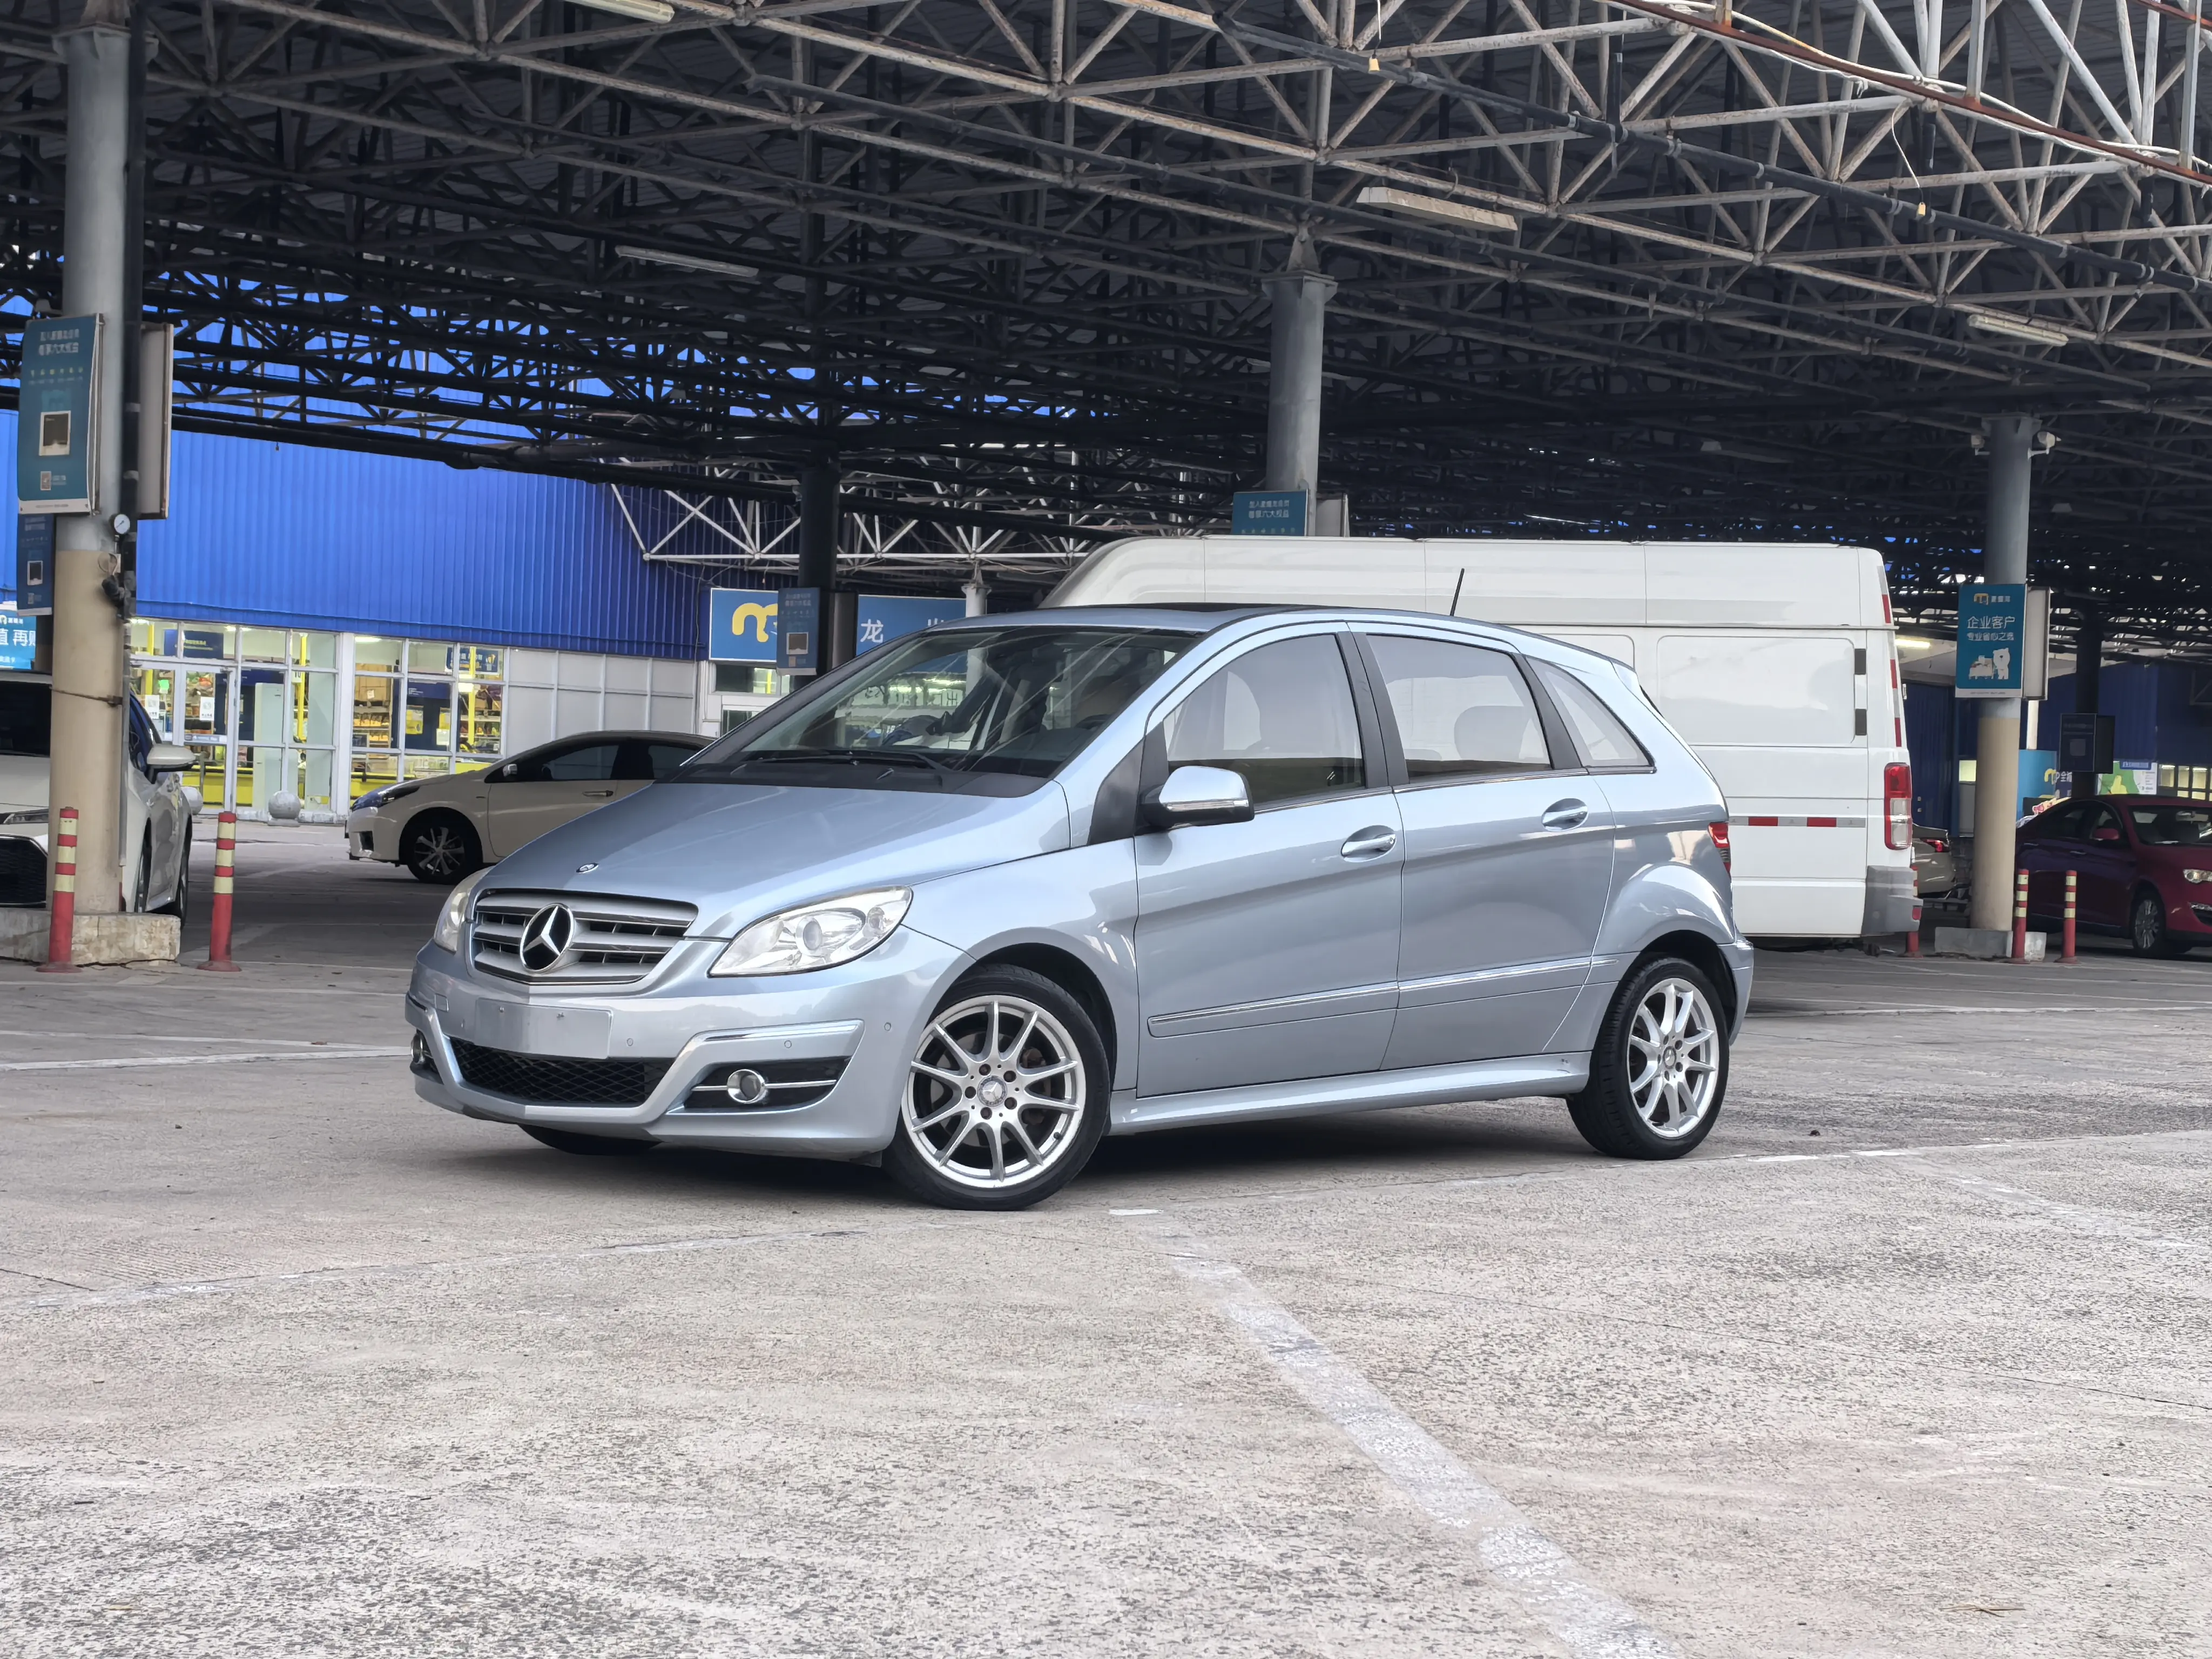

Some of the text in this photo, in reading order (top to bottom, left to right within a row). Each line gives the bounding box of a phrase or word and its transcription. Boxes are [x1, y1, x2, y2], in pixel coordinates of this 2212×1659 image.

[860, 619, 884, 643] 龙
[1967, 616, 2015, 629] 企业客户
